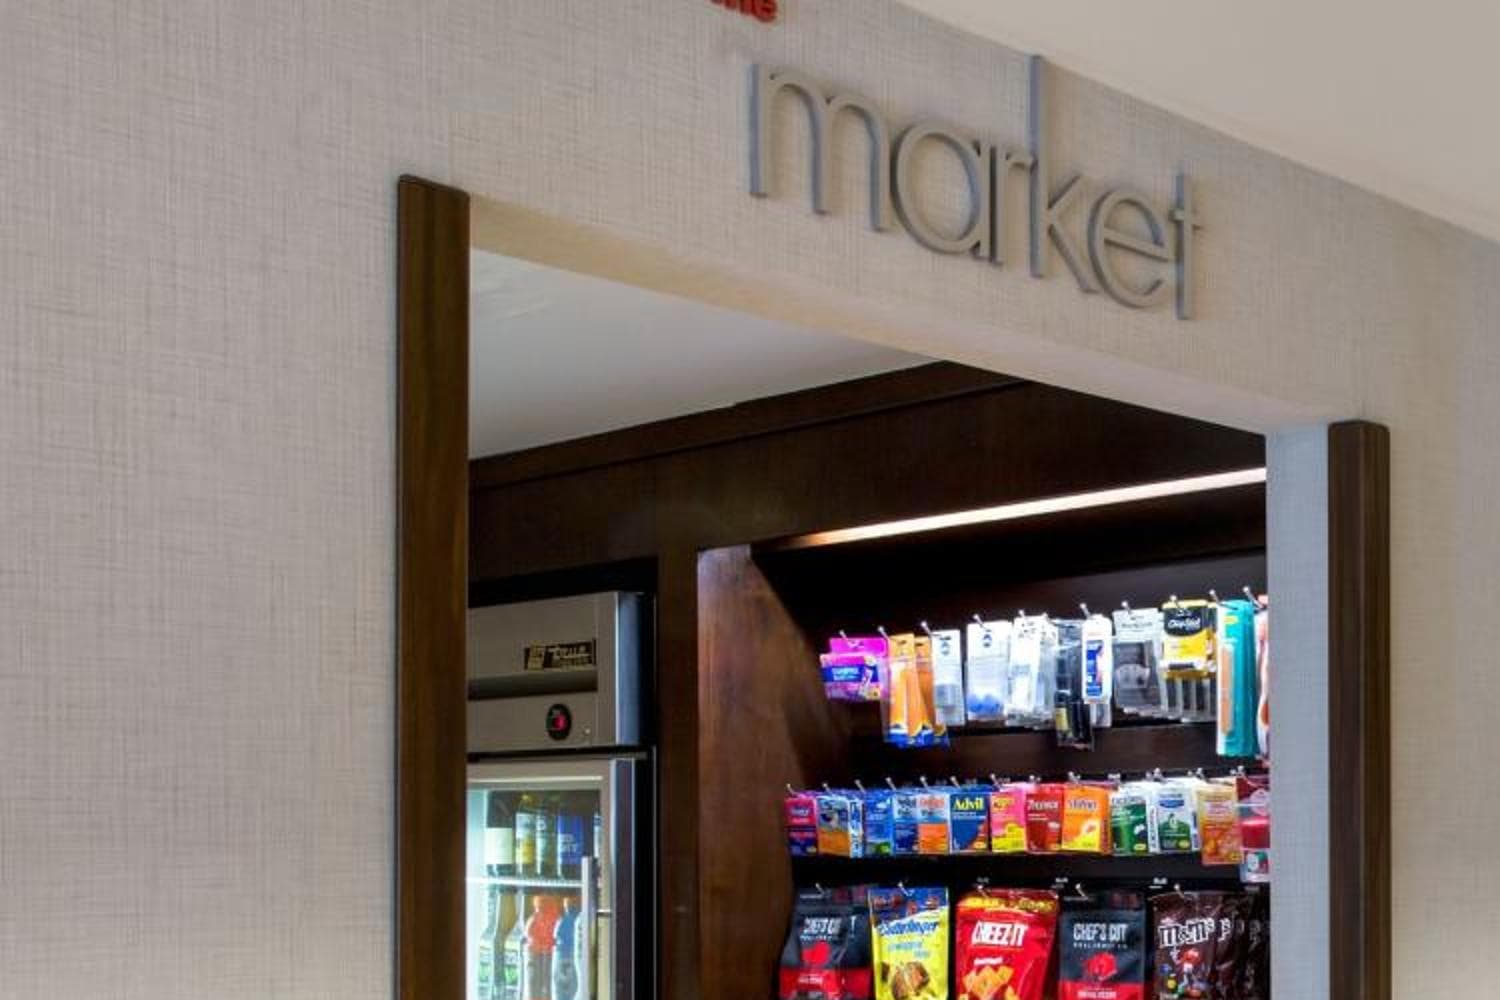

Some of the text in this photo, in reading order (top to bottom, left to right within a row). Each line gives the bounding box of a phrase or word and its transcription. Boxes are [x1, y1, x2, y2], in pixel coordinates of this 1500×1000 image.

[748, 55, 1204, 320] market
[953, 797, 984, 811] Advil
[1073, 922, 1129, 943] CHEF'S CUT
